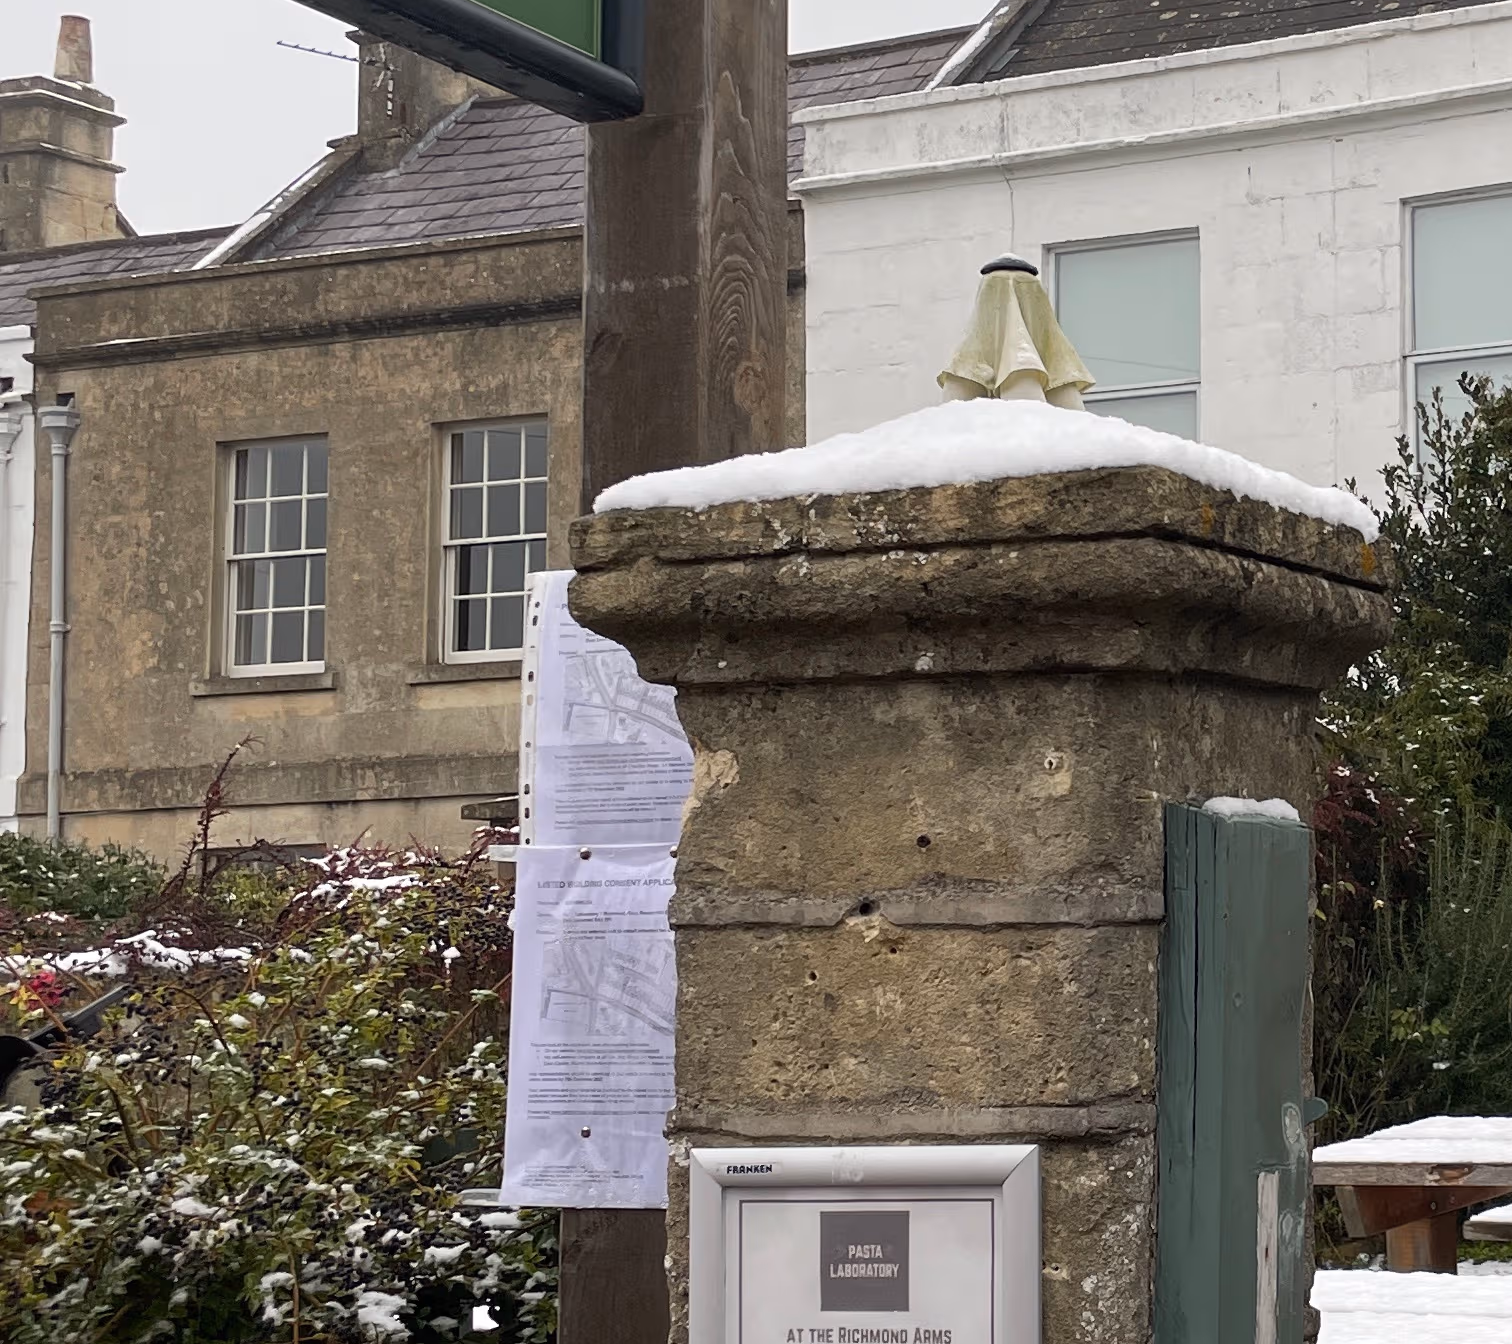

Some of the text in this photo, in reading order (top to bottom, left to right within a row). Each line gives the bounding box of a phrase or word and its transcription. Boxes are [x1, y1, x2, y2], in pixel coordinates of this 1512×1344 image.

[604, 879, 641, 887] CONSENT
[726, 1164, 773, 1174] FRANKEN
[848, 1244, 883, 1259] PASTA
[830, 1263, 899, 1278] LABORATORY
[786, 1327, 952, 1344] AT THE RICHMOND ARMS
